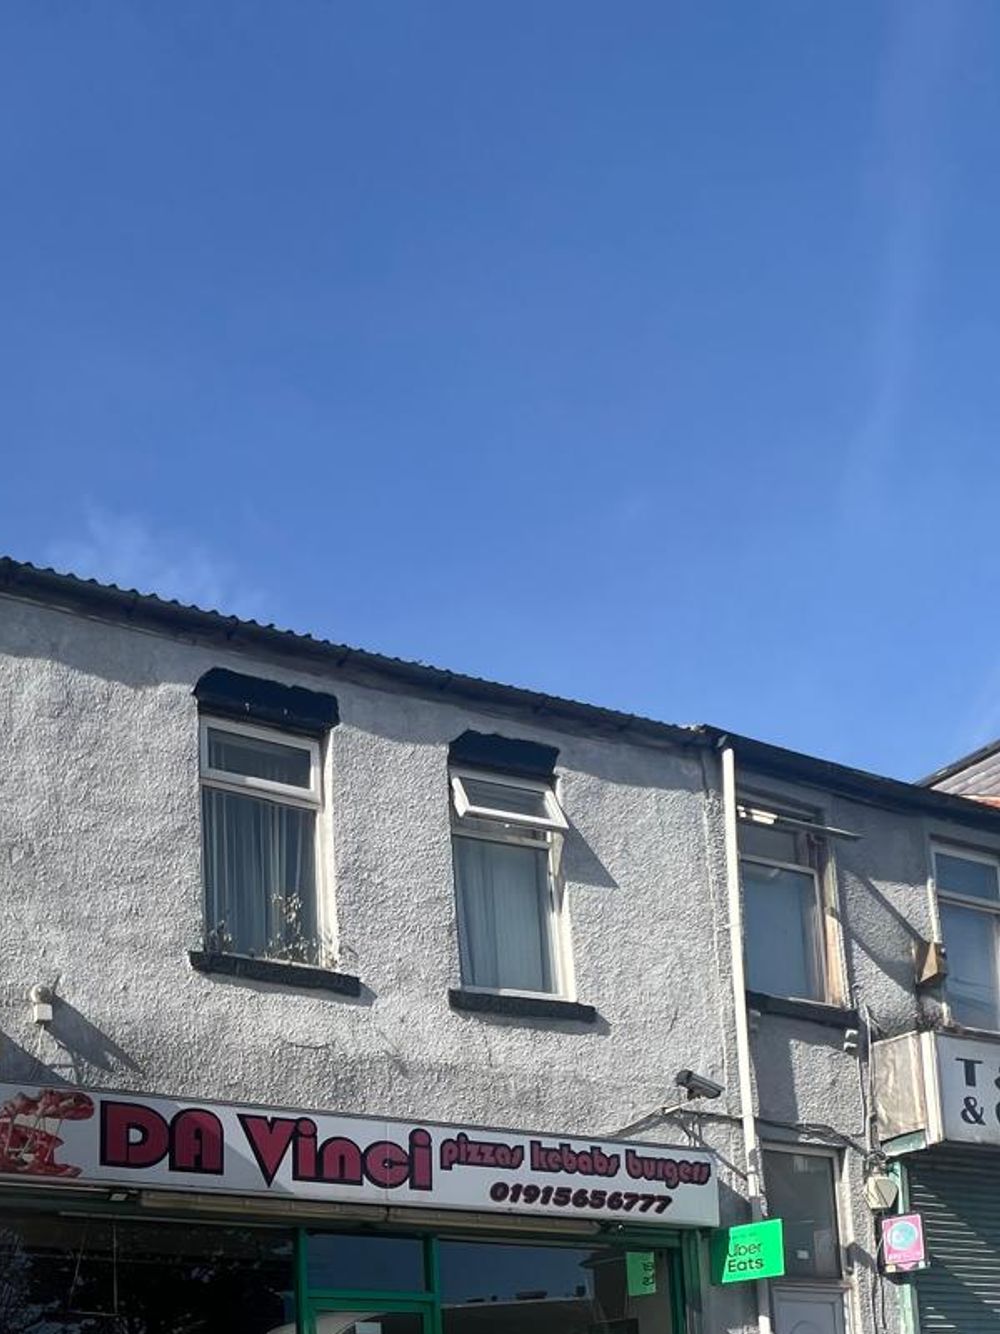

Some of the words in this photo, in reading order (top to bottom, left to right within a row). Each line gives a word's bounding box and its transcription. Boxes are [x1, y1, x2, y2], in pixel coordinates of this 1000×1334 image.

[955, 1057, 984, 1087] T
[960, 1096, 987, 1126] &
[100, 1100, 224, 1176] DA
[237, 1113, 433, 1191] Vinci
[440, 1132, 524, 1170] pizzas
[530, 1140, 621, 1177] kebabs
[625, 1148, 712, 1189] burgers
[490, 1181, 673, 1214] 01915656777
[728, 1258, 764, 1273] Eats
